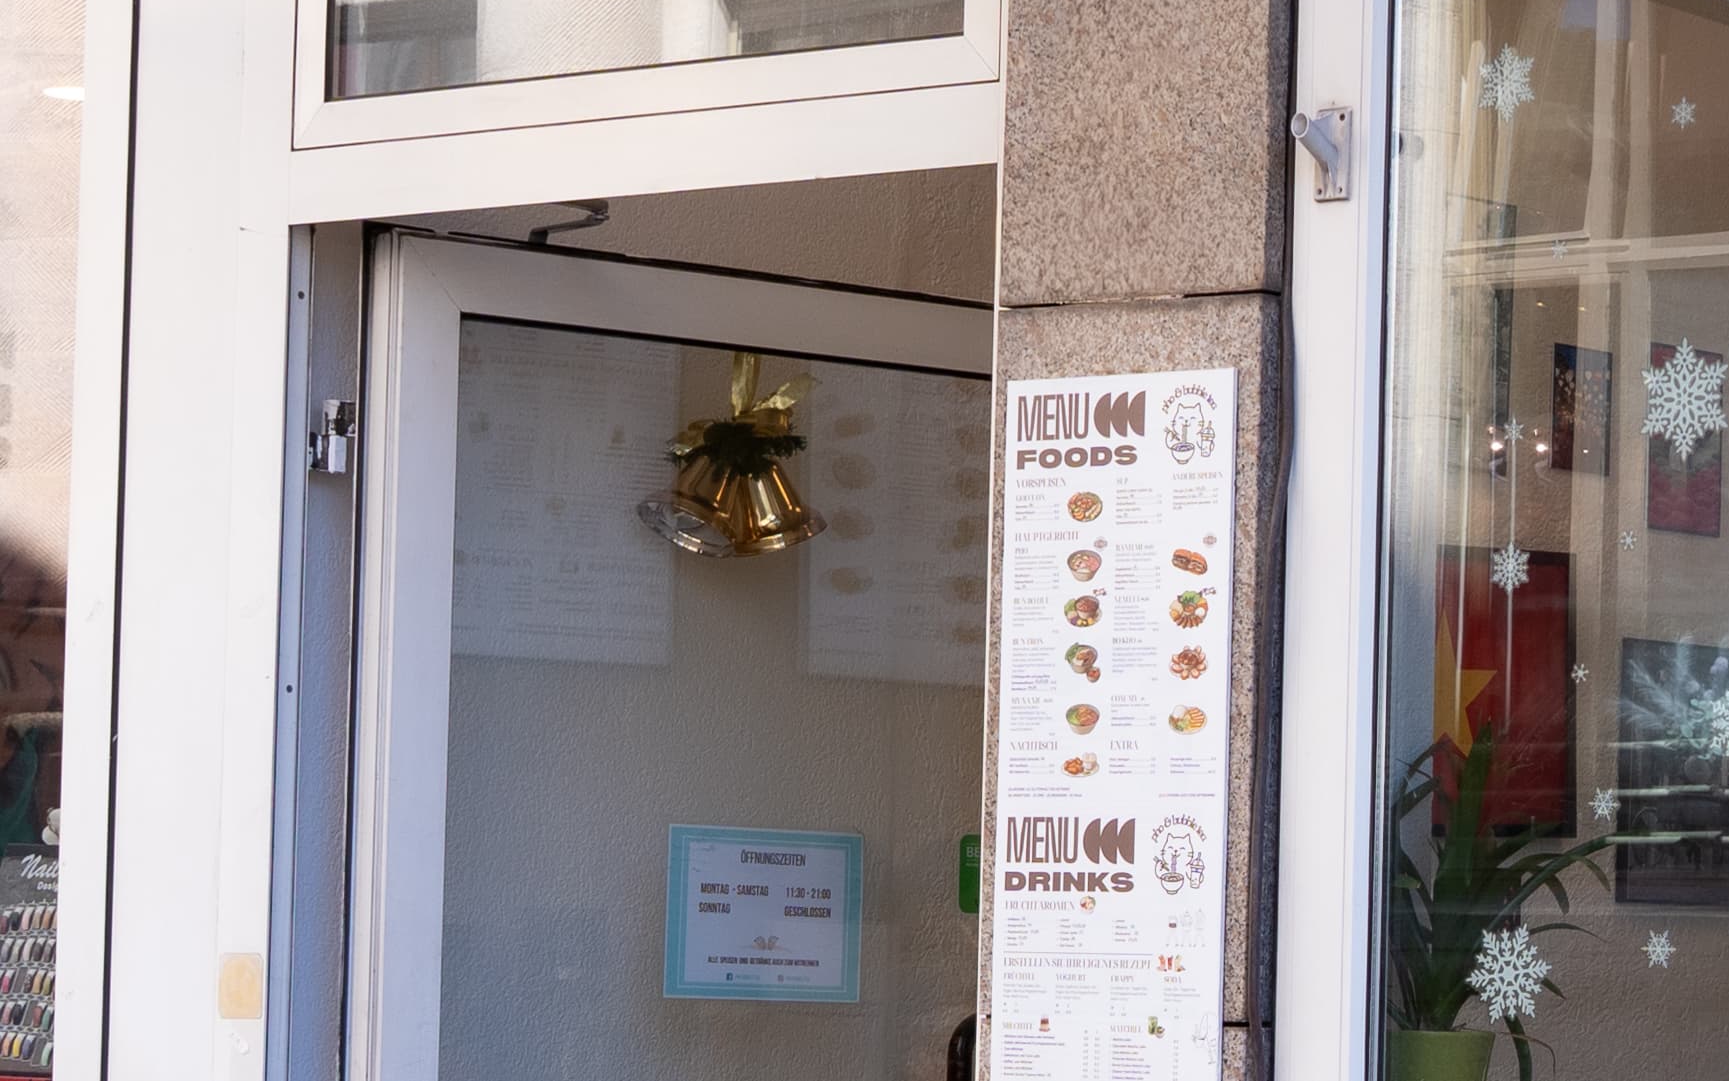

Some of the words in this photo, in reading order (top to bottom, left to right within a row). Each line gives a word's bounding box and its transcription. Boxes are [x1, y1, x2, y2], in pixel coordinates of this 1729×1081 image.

[1017, 392, 1090, 442] MENU
[1016, 445, 1138, 470] FOODS
[1016, 477, 1066, 489] VORSPEISEN
[1014, 530, 1080, 542] HAUPTGERICHT
[1009, 740, 1058, 751] NACHTISCH
[1110, 740, 1139, 750] EXTRA
[1006, 816, 1079, 864] MENU
[740, 850, 806, 867] ÖFFNUNGSZEITEN
[700, 882, 730, 895] MONTAG
[736, 884, 769, 897] SAMSTAG
[786, 887, 806, 899] 11:30
[810, 888, 832, 900] 21:00
[1004, 872, 1134, 893] DRINKS
[698, 902, 731, 914] SONNTAG
[784, 905, 832, 919] GESCHLOSSEN
[1005, 900, 1075, 911] FRUCHTAROMEN
